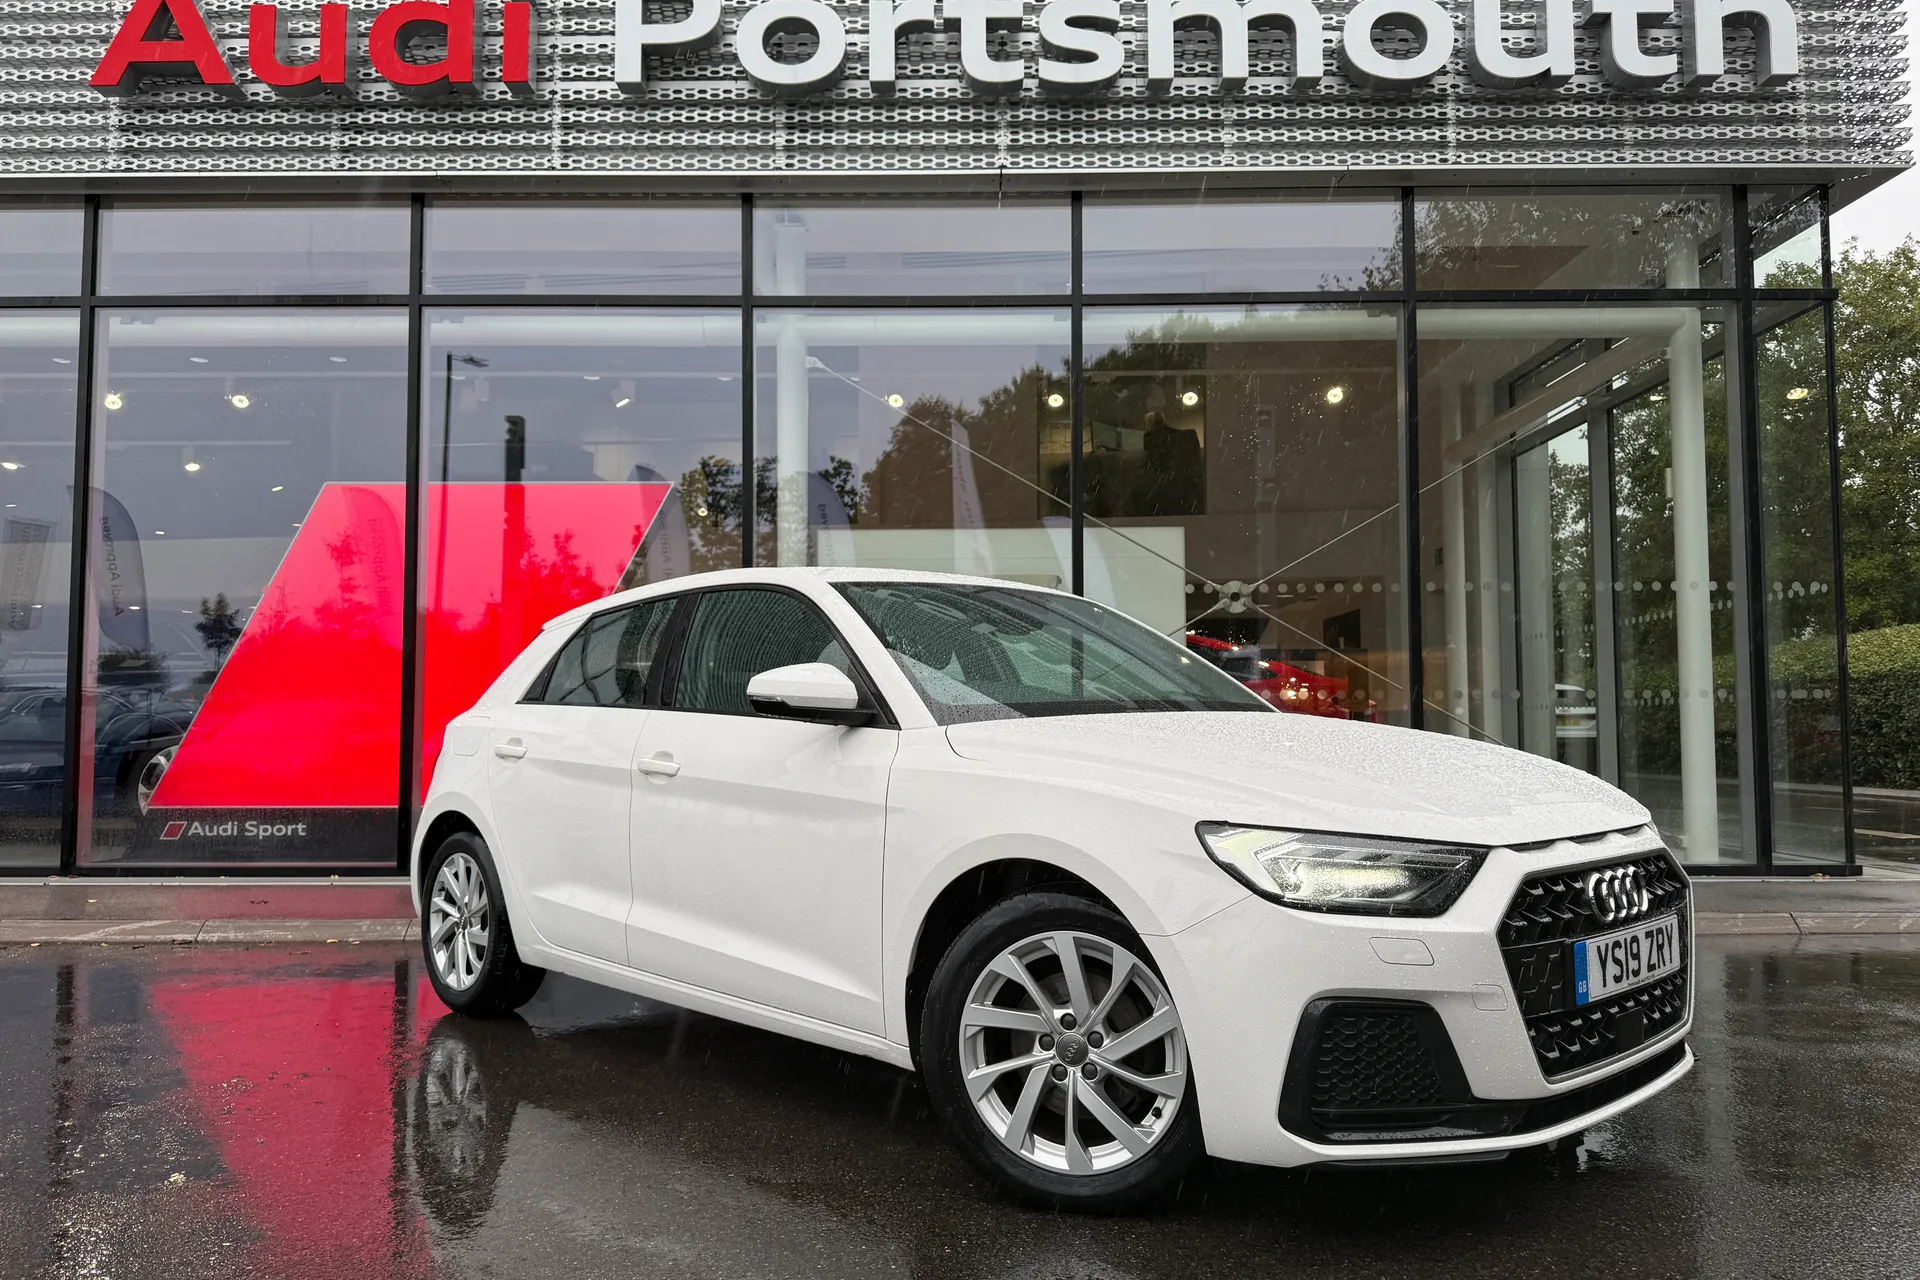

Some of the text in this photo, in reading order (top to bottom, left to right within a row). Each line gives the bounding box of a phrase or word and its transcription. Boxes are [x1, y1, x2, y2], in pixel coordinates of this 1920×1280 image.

[89, 0, 1799, 86] Audi Portsmouth
[187, 821, 307, 839] Audi Sport
[1597, 923, 1673, 988] YS19 ZRY
[1578, 980, 1587, 993] GB
